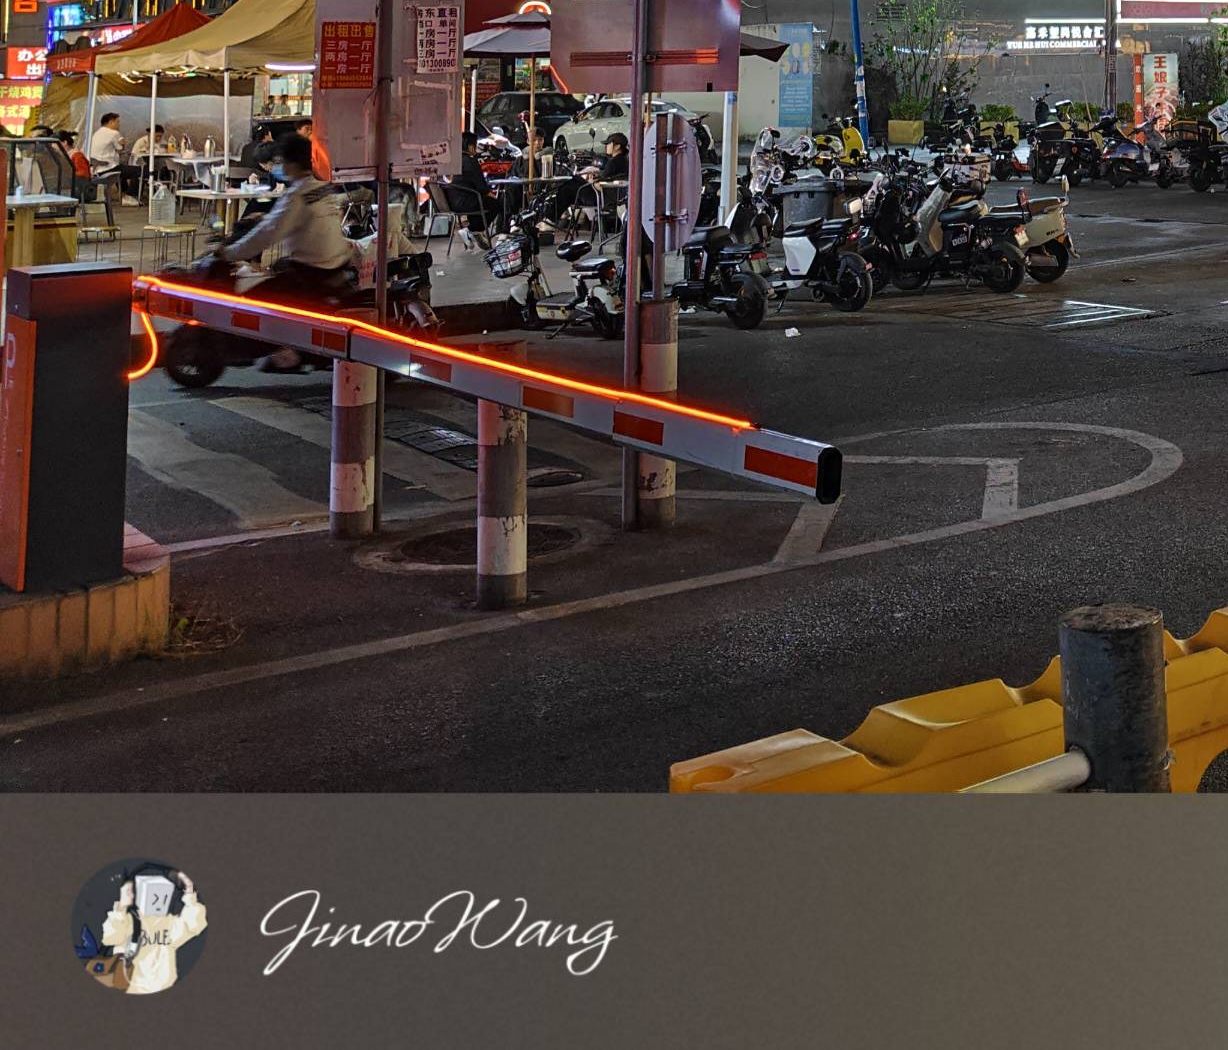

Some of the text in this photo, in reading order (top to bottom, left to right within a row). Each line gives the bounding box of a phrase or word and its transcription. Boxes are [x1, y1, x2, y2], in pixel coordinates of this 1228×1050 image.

[325, 24, 374, 37] 出租出售
[325, 40, 372, 51] 三房一厅
[324, 63, 373, 74] 一房一厅
